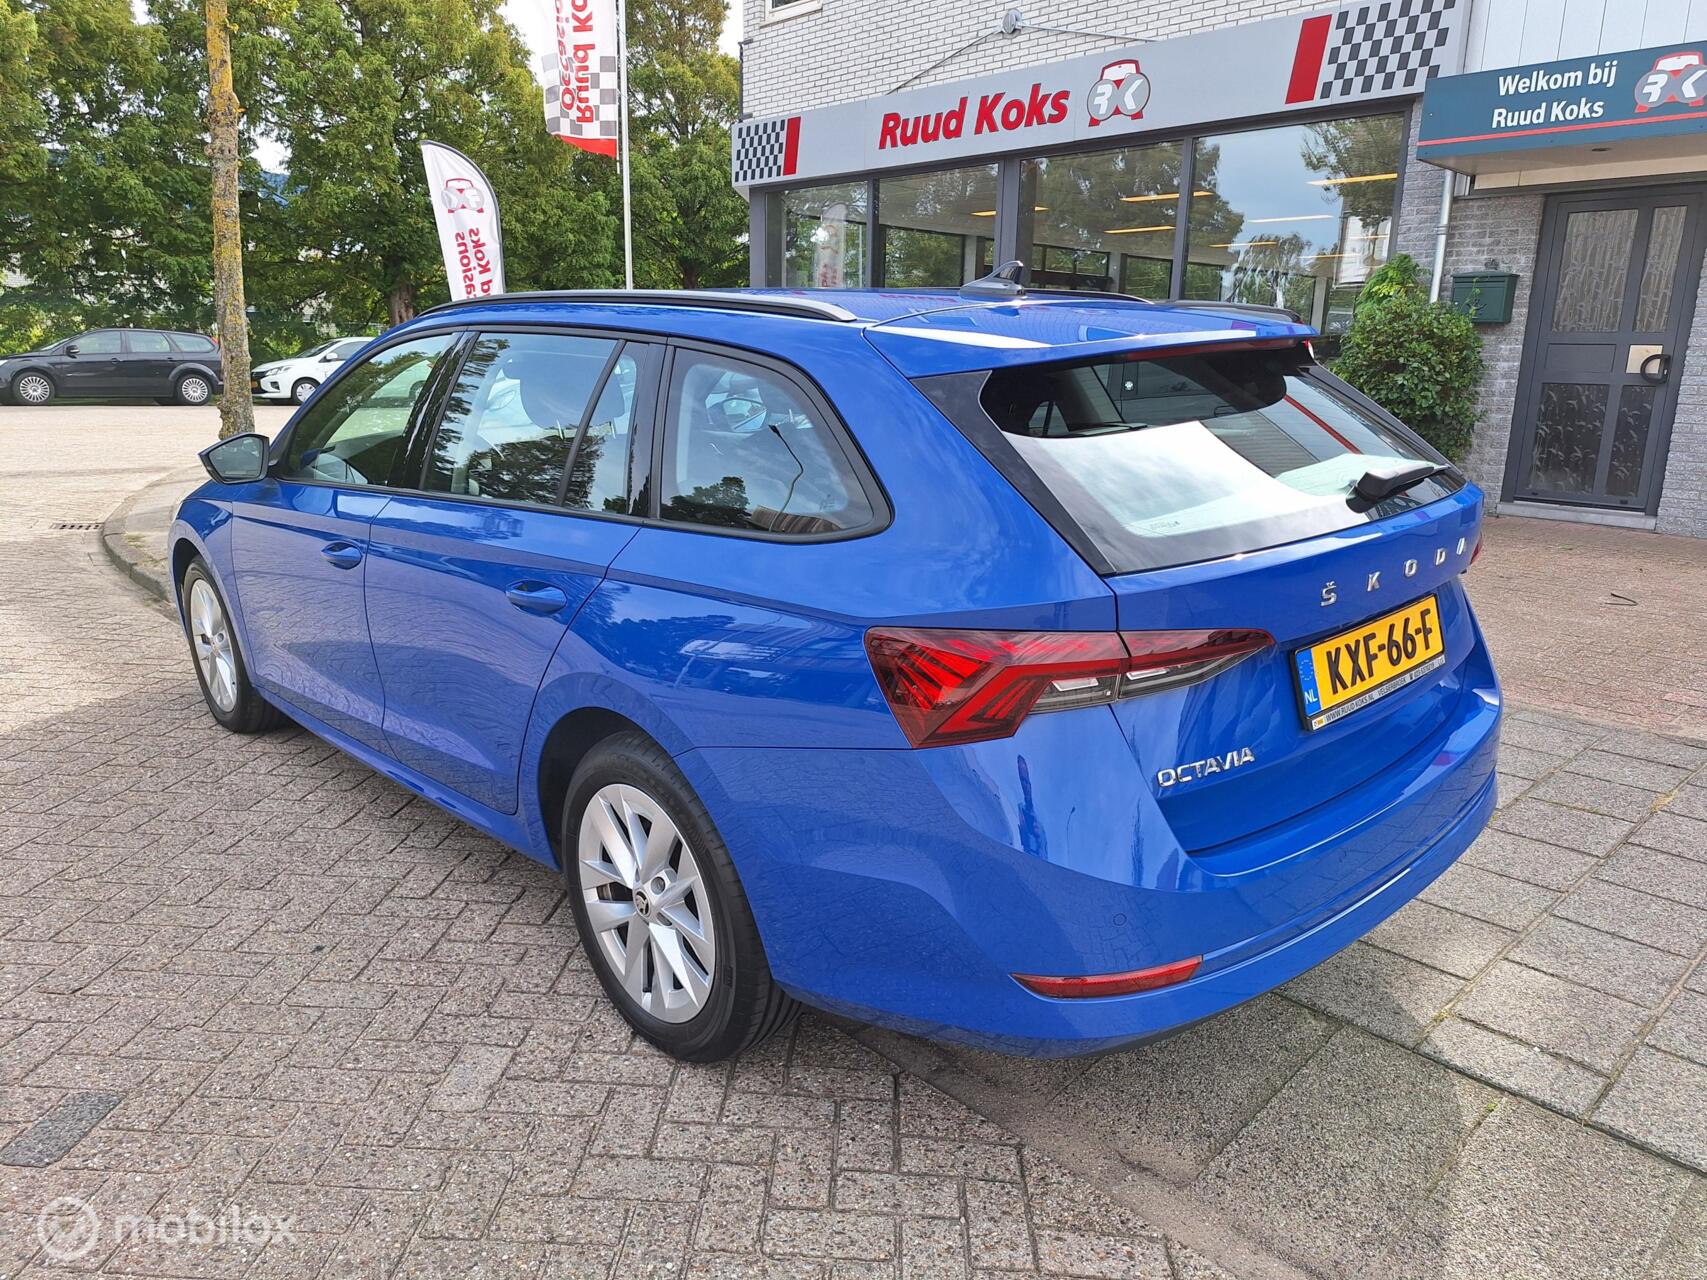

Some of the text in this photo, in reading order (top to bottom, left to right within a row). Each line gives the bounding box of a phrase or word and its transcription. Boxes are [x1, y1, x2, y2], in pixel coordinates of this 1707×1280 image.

[1498, 60, 1618, 96] Welkom bij
[878, 82, 1071, 151] Ruud Koks
[1491, 98, 1604, 129] Ruud Koks
[1326, 608, 1433, 695] KXF-66-F
[1304, 688, 1318, 705] NL
[1156, 747, 1256, 788] OCTAVIA
